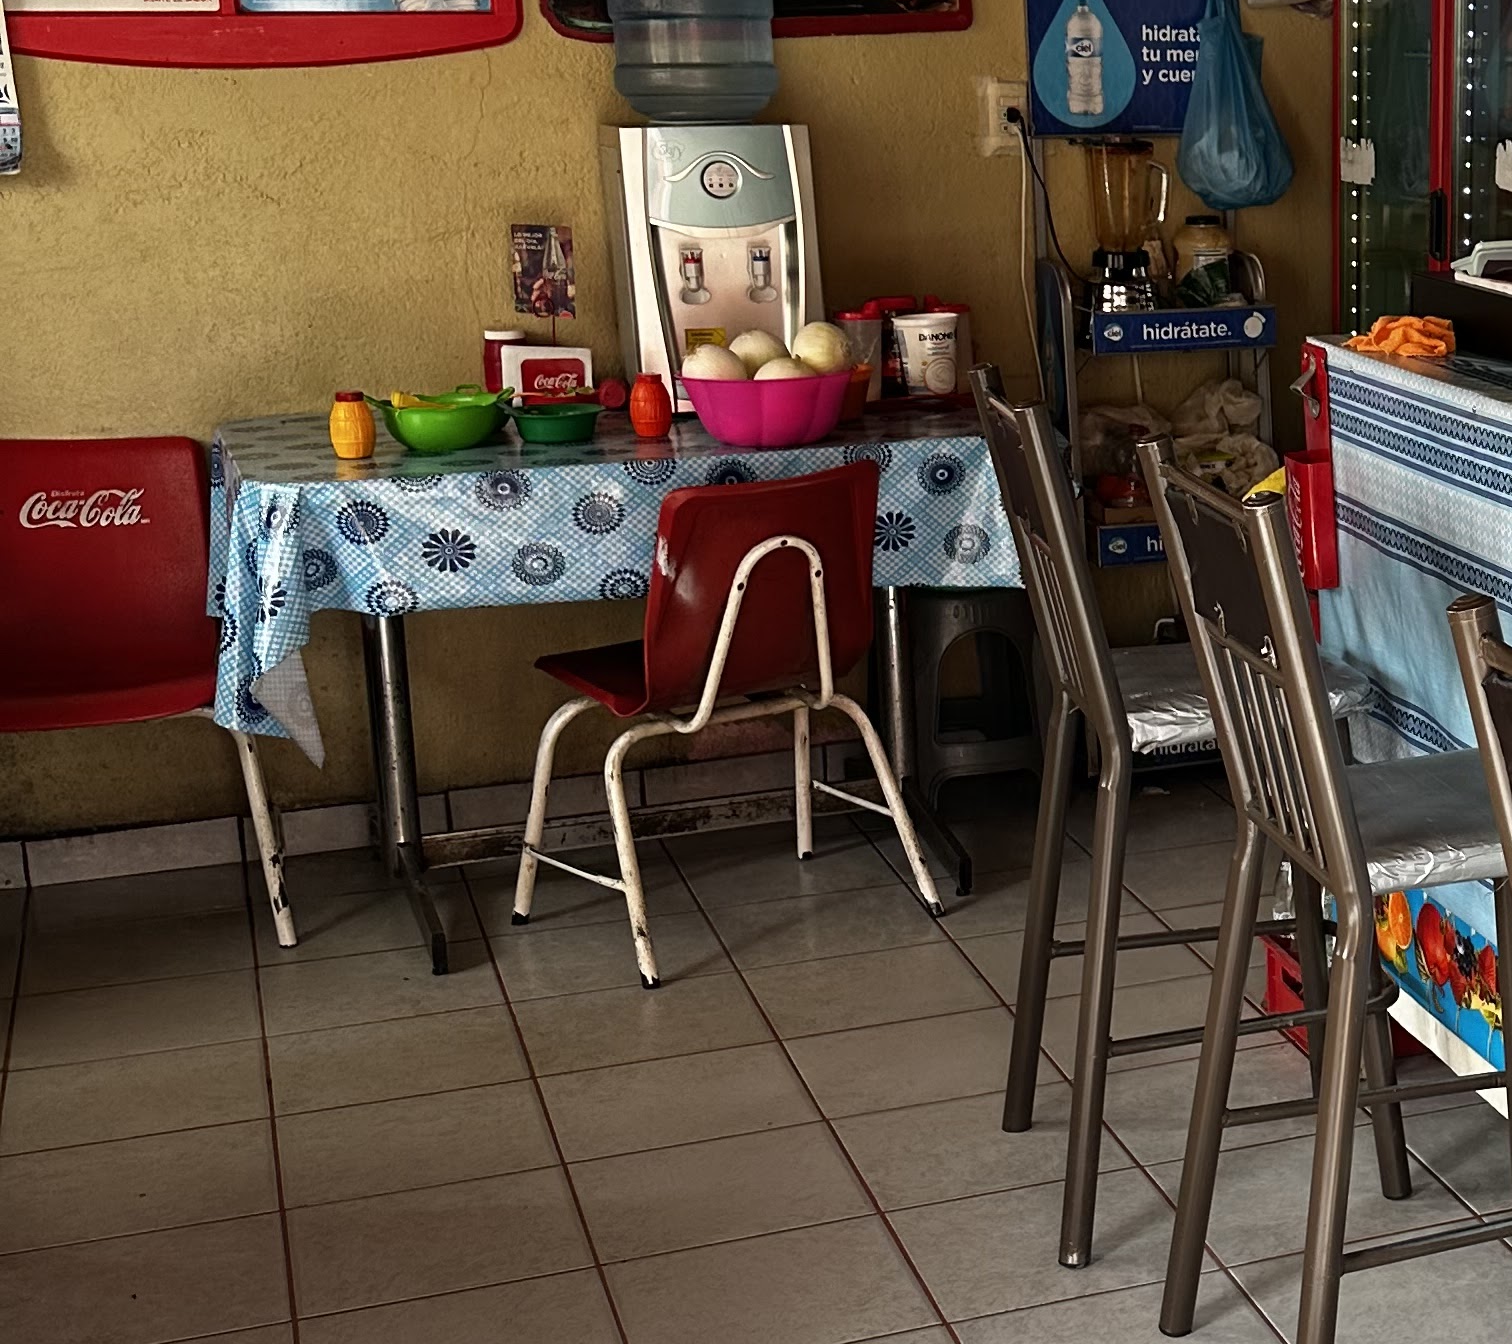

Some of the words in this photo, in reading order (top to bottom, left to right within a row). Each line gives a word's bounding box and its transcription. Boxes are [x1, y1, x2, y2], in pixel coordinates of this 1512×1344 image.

[1142, 46, 1160, 62] tu
[1142, 69, 1154, 85] y
[918, 331, 954, 342] DANONE
[534, 373, 578, 389] Coca-Cola
[19, 488, 145, 529] Coca-Cola
